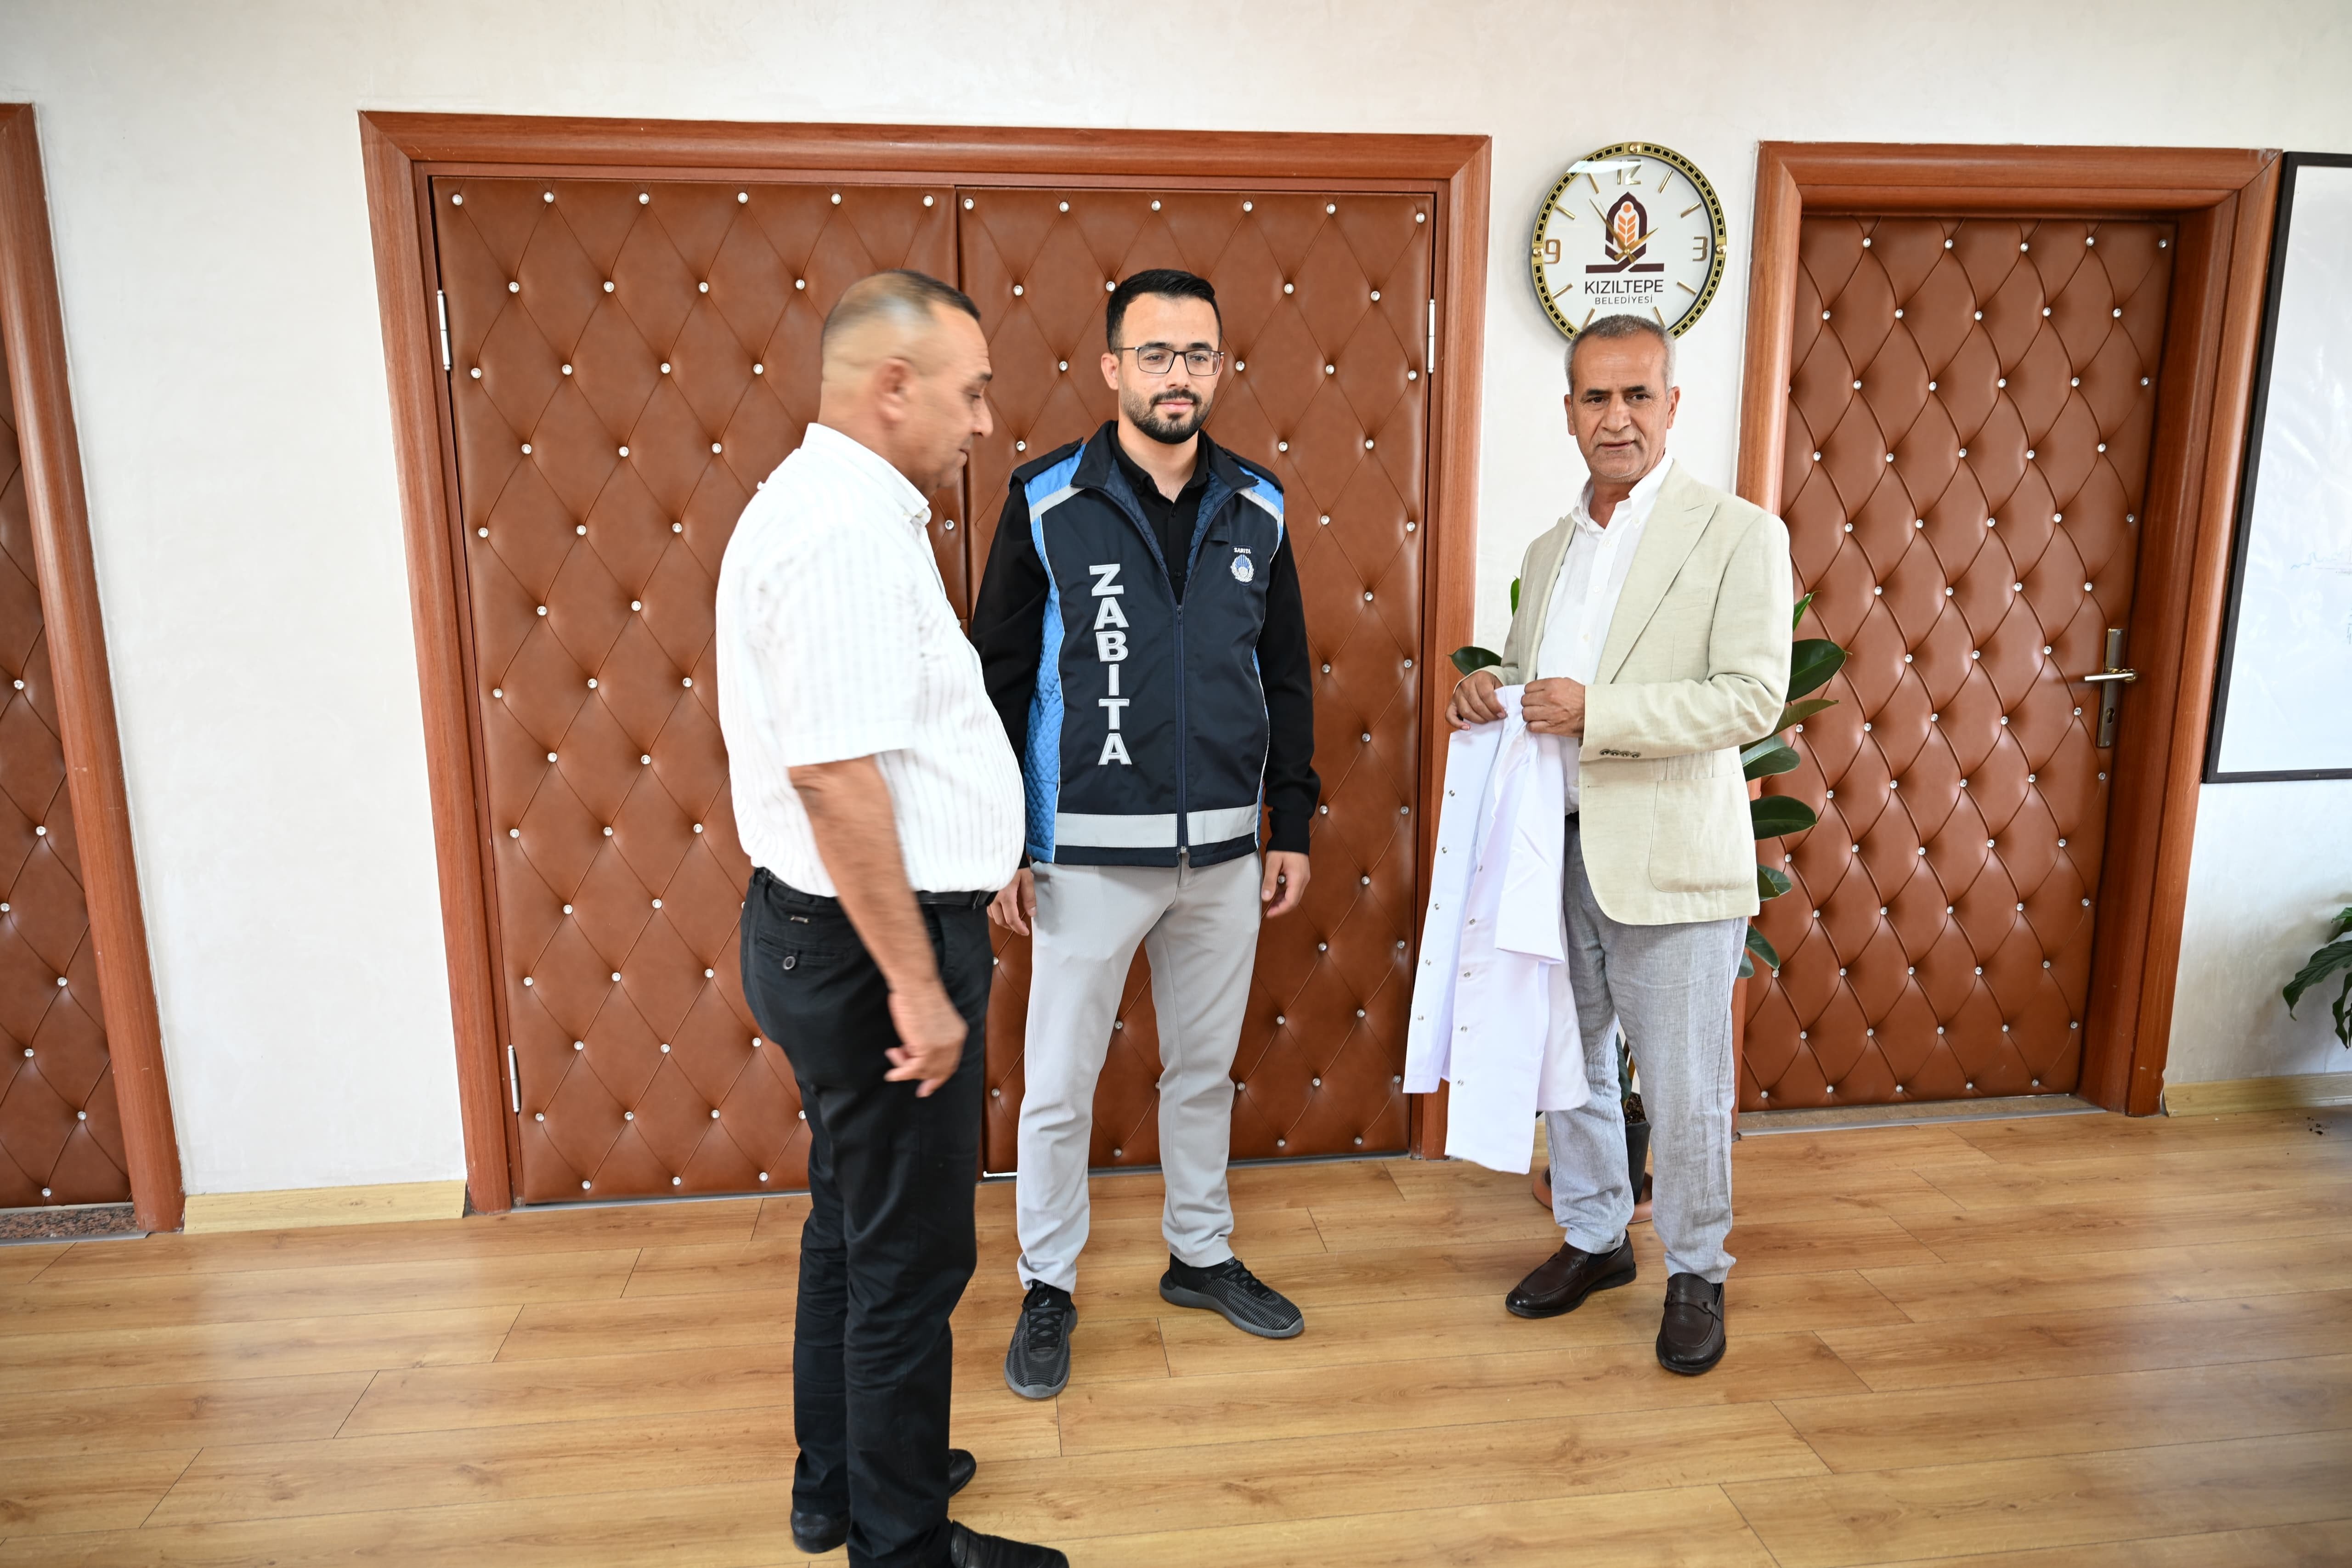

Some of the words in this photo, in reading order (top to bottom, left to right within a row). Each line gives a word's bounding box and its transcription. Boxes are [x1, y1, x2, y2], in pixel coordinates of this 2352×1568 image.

[1617, 158, 1642, 185] 12
[1544, 239, 1561, 264] 9
[1692, 236, 1708, 261] 3
[1584, 279, 1664, 294] KIZILTEPE
[1595, 294, 1653, 305] BELEDİYESİ
[1089, 563, 1132, 765] ZABITA
